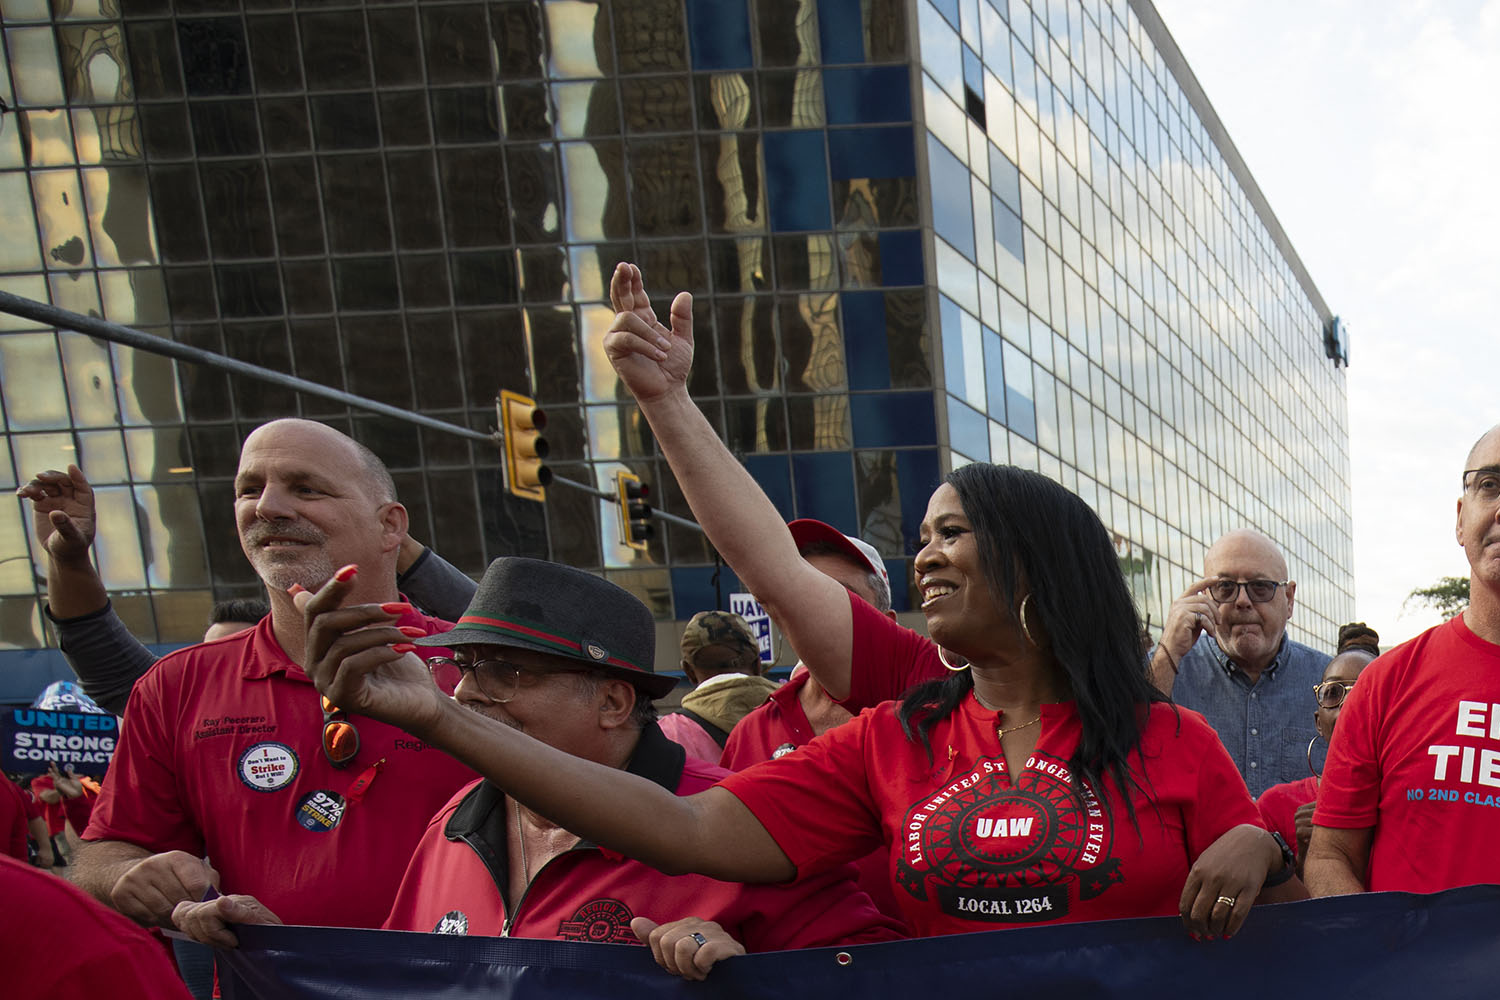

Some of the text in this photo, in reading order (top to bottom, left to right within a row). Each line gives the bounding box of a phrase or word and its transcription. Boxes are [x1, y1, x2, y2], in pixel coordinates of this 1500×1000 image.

[14, 709, 116, 731] UNITED
[203, 718, 220, 728] Ray
[195, 725, 276, 739] Assistant Director
[15, 732, 114, 751] STRONG
[13, 748, 113, 763] CONTRACT
[263, 749, 268, 757] I
[251, 764, 285, 775] Strike
[1407, 789, 1424, 801] NO
[1428, 788, 1459, 802] 2ND
[307, 800, 337, 822] READY TO
[313, 792, 344, 816] 97%
[908, 812, 927, 865] LABOR
[923, 772, 980, 811] UNITED
[983, 757, 1072, 785] STONGE
[1081, 824, 1104, 865] EVER
[301, 804, 332, 828] STRIKE
[975, 817, 1034, 839] UAW
[580, 903, 617, 919] REGION
[958, 896, 1053, 915] LOCAL 1264
[439, 919, 464, 933] 97%
